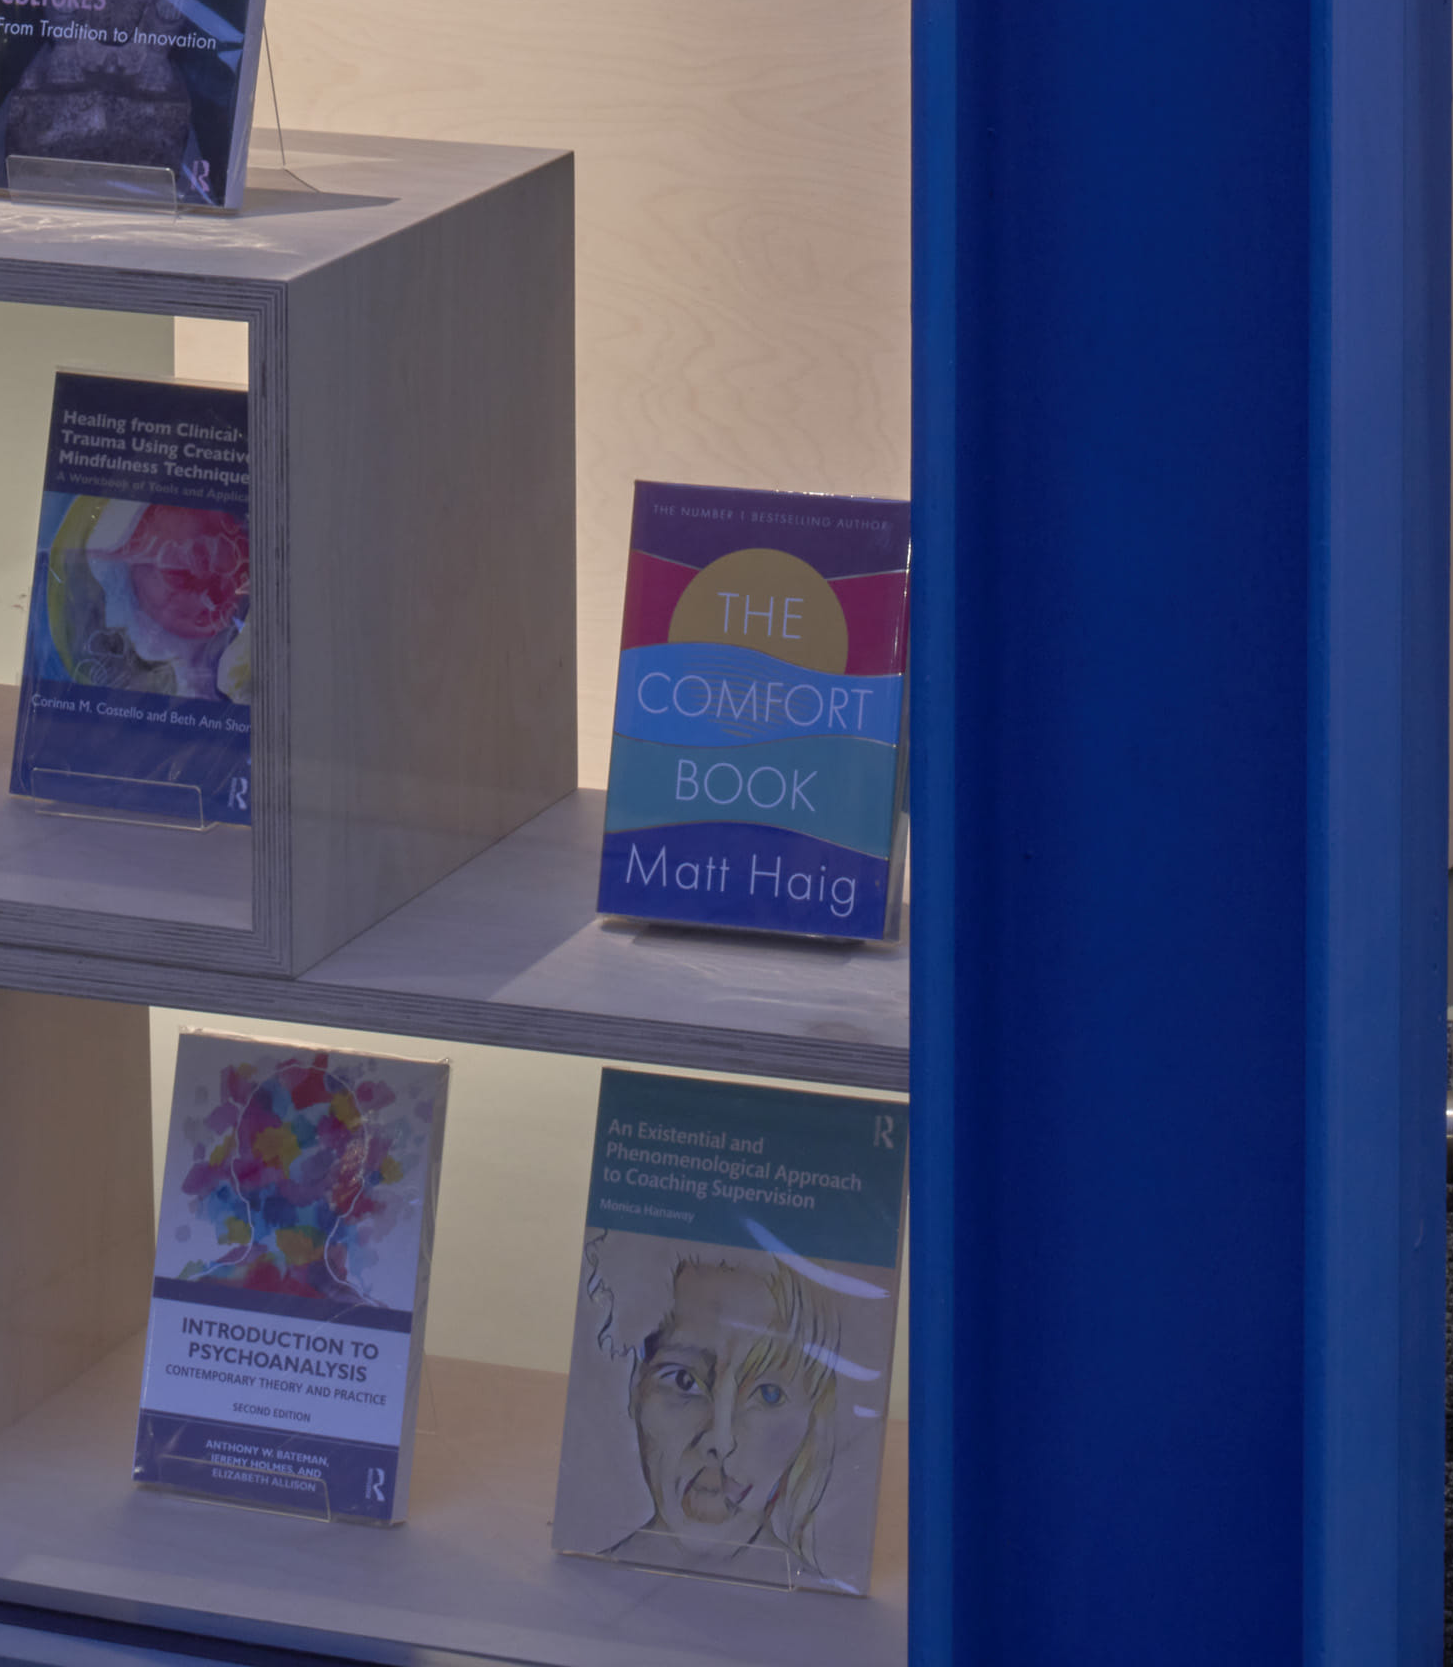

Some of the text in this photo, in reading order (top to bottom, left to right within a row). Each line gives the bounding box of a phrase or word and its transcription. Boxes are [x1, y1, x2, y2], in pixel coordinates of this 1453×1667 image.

[40, 20, 107, 42] Tradition
[113, 28, 128, 43] to
[134, 27, 216, 50] Innovation
[61, 430, 178, 460] Trauma Using
[63, 411, 238, 443] Healing from Clinical
[59, 450, 158, 474] Mindfulness
[653, 504, 888, 531] THE NUMBER BESTSELLING AUTHOR
[717, 592, 804, 640] THE
[32, 694, 222, 730] Corinna Costello and Beth Ann
[637, 672, 874, 731] COMFORT
[675, 759, 818, 812] BOOK
[626, 843, 856, 918] Matt Haig
[607, 1118, 764, 1155] An Existential and
[606, 1141, 862, 1193] Phenomenological Approach
[603, 1167, 816, 1210] to Coaching Supervision
[600, 1199, 695, 1224] Monica Hanaway
[181, 1317, 379, 1360] INTRODUCTION TO
[188, 1341, 368, 1383] PSYCHOANALYSIS
[165, 1364, 387, 1406] CONTEMPORARY THEORY AND PRACTICE
[232, 1402, 312, 1423] SECOND EDITION
[205, 1439, 259, 1456] ANTHONY
[212, 1468, 316, 1493] ELIZABETH ALLISON
[297, 1467, 322, 1479] AND
